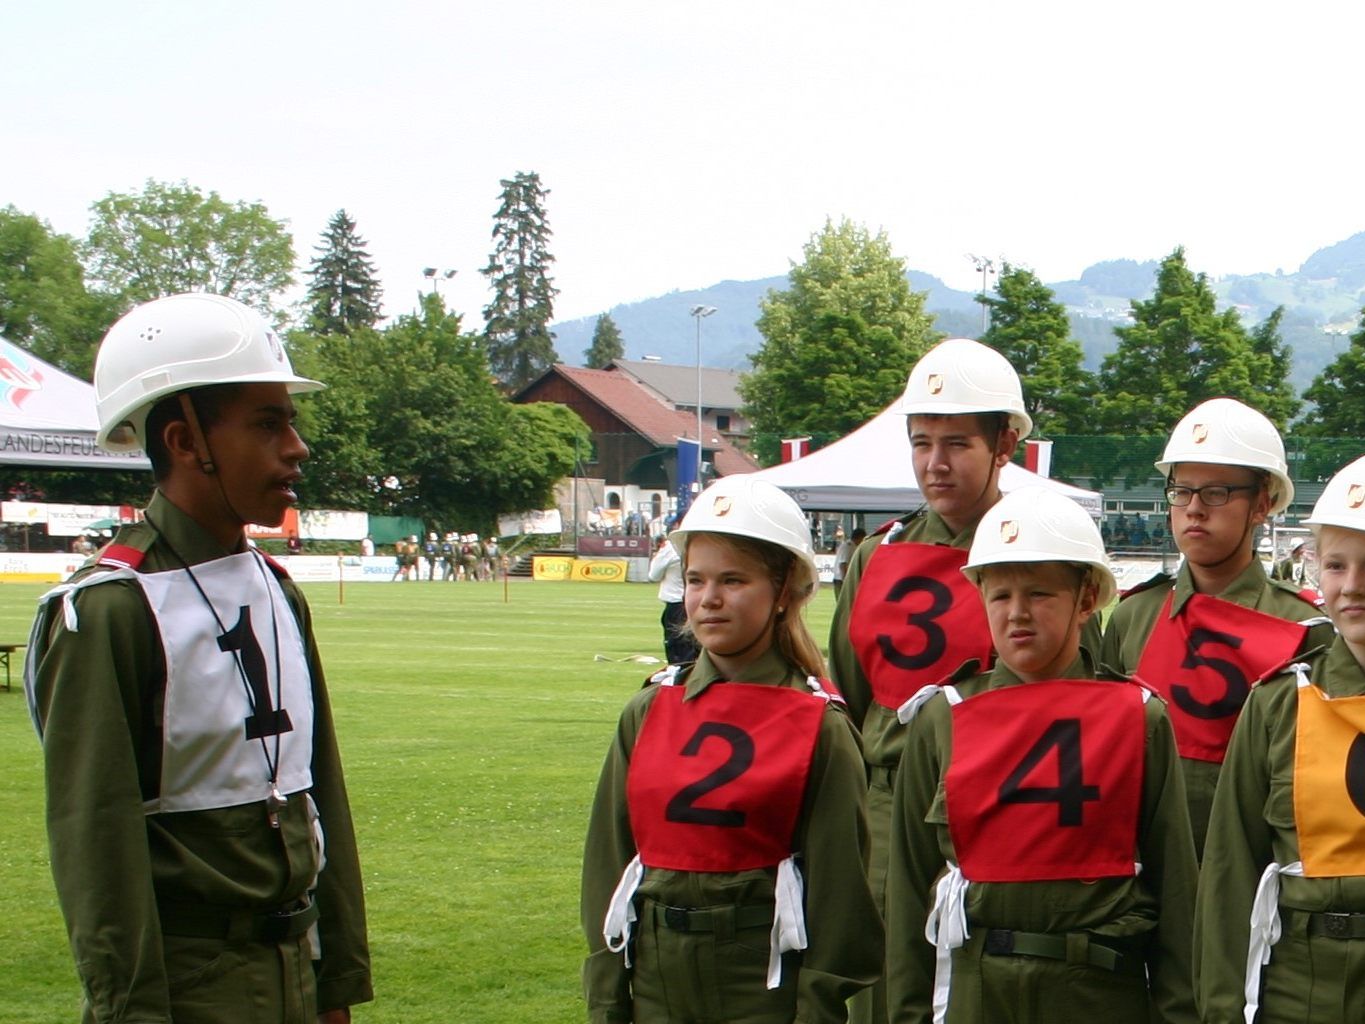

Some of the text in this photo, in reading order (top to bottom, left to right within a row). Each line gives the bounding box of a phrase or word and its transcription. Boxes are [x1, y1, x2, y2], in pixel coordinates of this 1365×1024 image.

[591, 565, 618, 576] RAUCH
[217, 605, 293, 740] 1
[876, 574, 954, 670] 3
[1170, 627, 1250, 720] 5
[665, 721, 756, 828] 2
[997, 717, 1101, 828] 4
